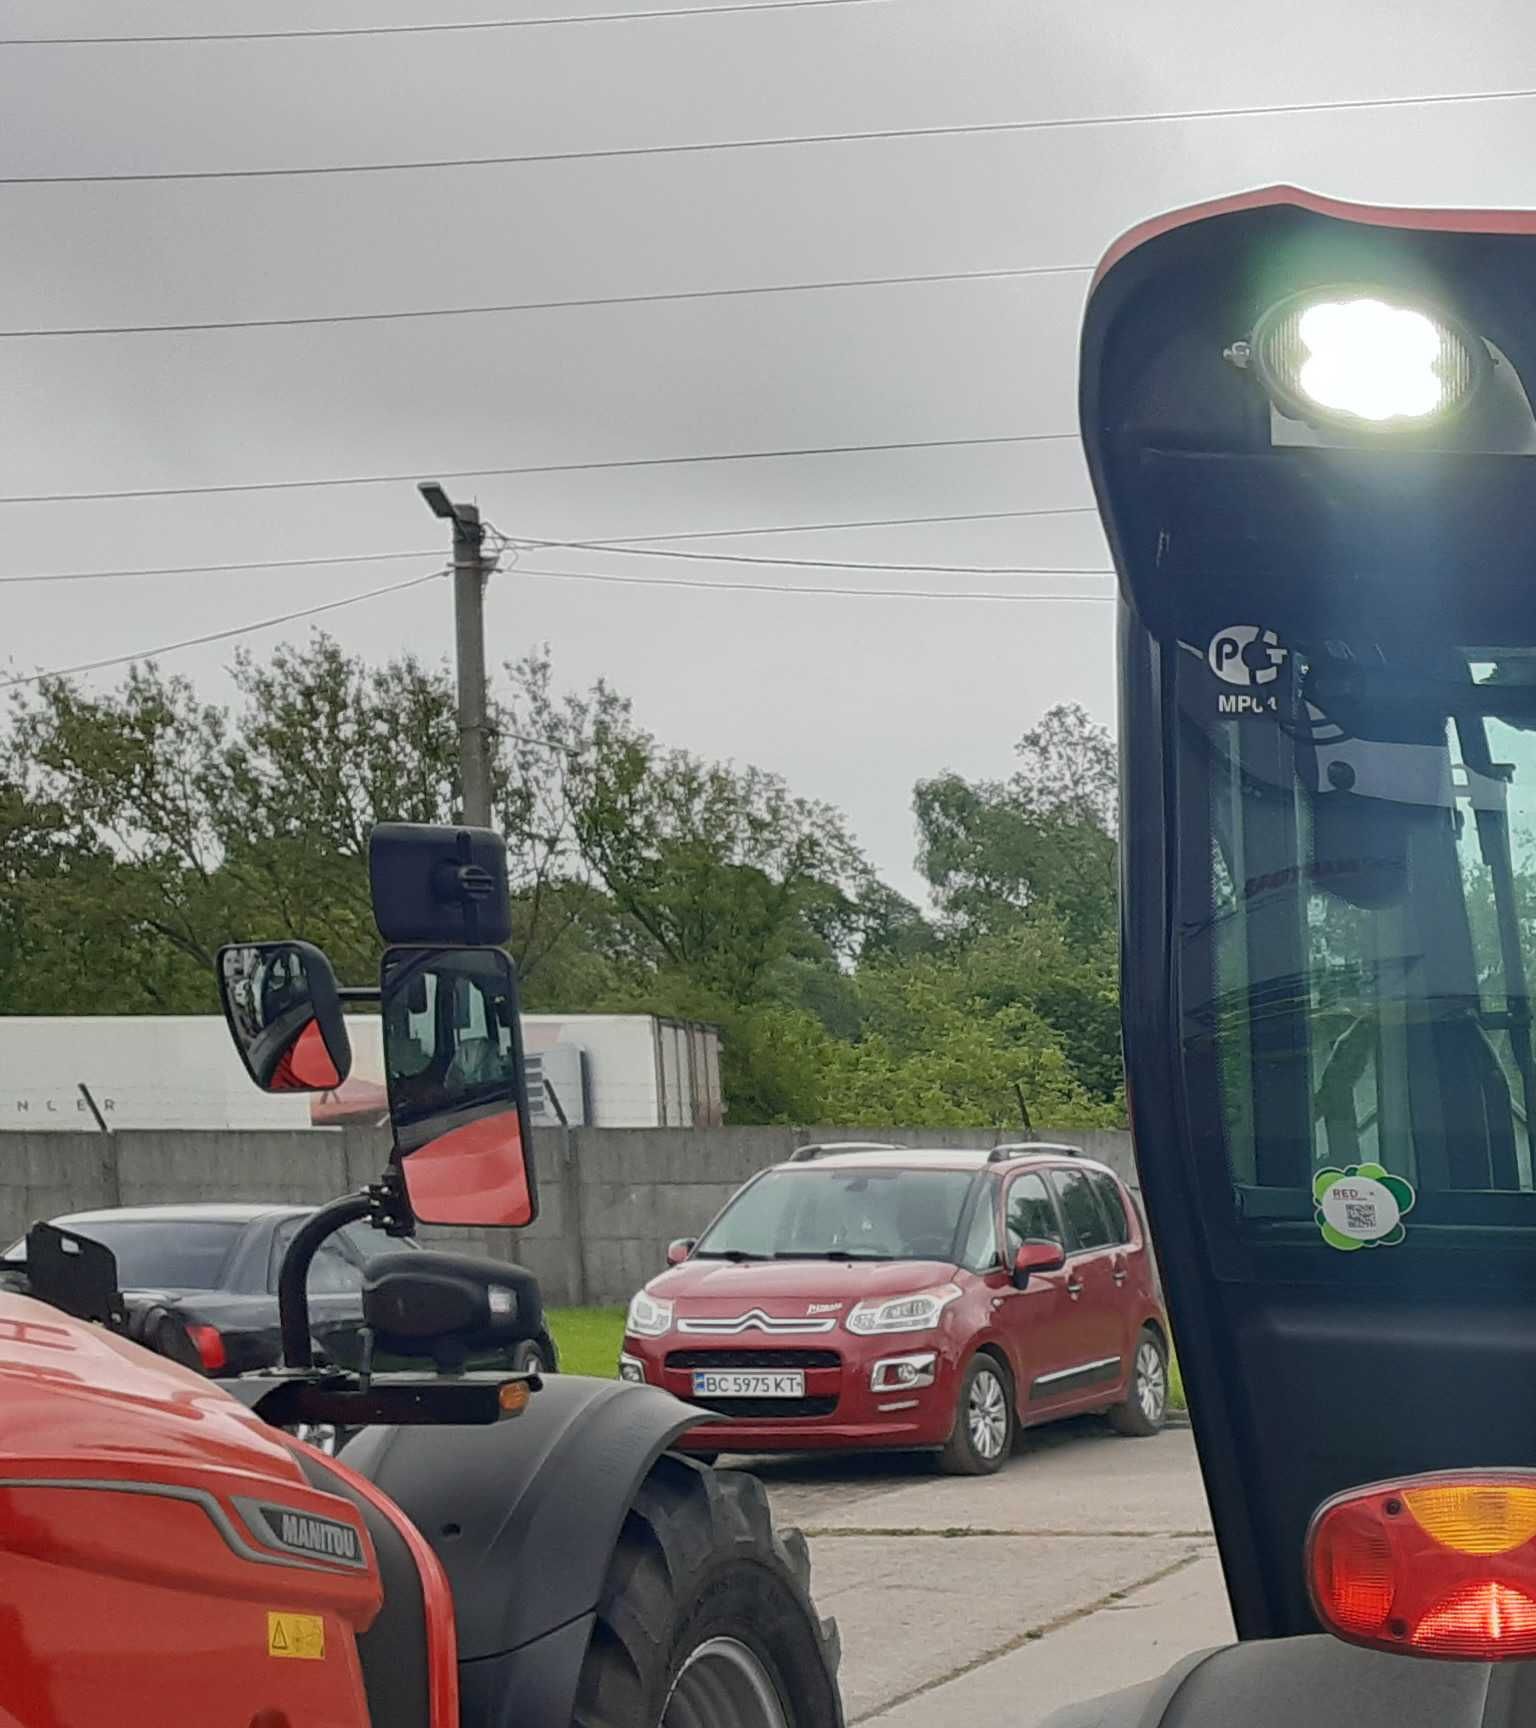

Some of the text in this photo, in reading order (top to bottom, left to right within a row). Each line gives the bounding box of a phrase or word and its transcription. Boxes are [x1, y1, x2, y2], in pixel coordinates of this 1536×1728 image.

[706, 1376, 797, 1393] BC 5975 KT
[282, 1513, 356, 1558] MANITOU
